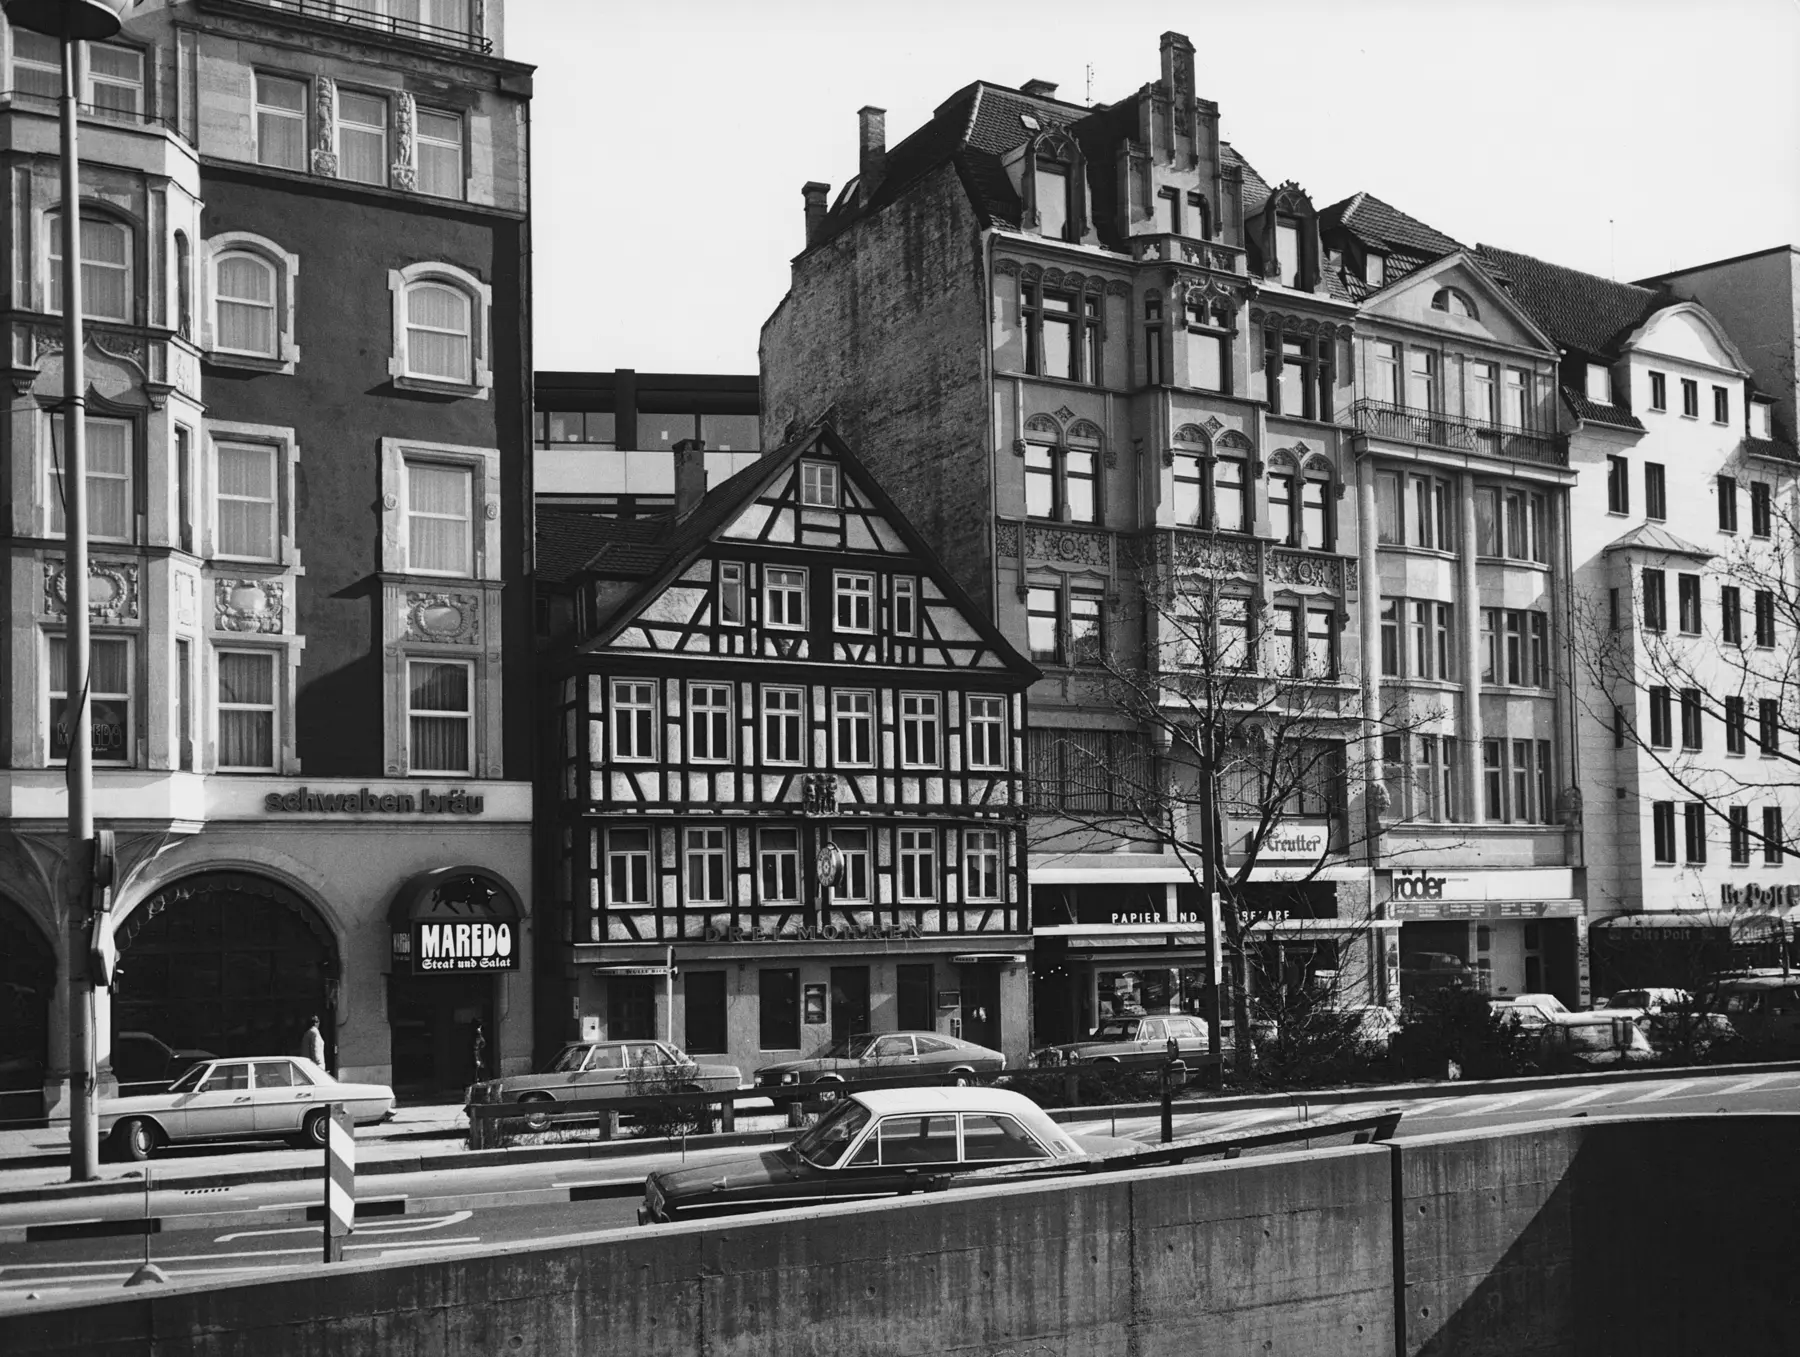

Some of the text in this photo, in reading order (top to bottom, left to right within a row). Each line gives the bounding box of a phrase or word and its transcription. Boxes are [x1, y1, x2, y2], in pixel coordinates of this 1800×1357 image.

[57, 722, 121, 747] MEDO
[265, 786, 484, 814] schwaben bräu
[1394, 869, 1446, 900] röder
[1111, 912, 1161, 924] PAPIER
[421, 923, 511, 958] MAREDO
[705, 924, 924, 942] DREI MOHREN
[422, 958, 455, 970] Steak
[457, 958, 477, 968] und
[479, 957, 511, 968] Salat
